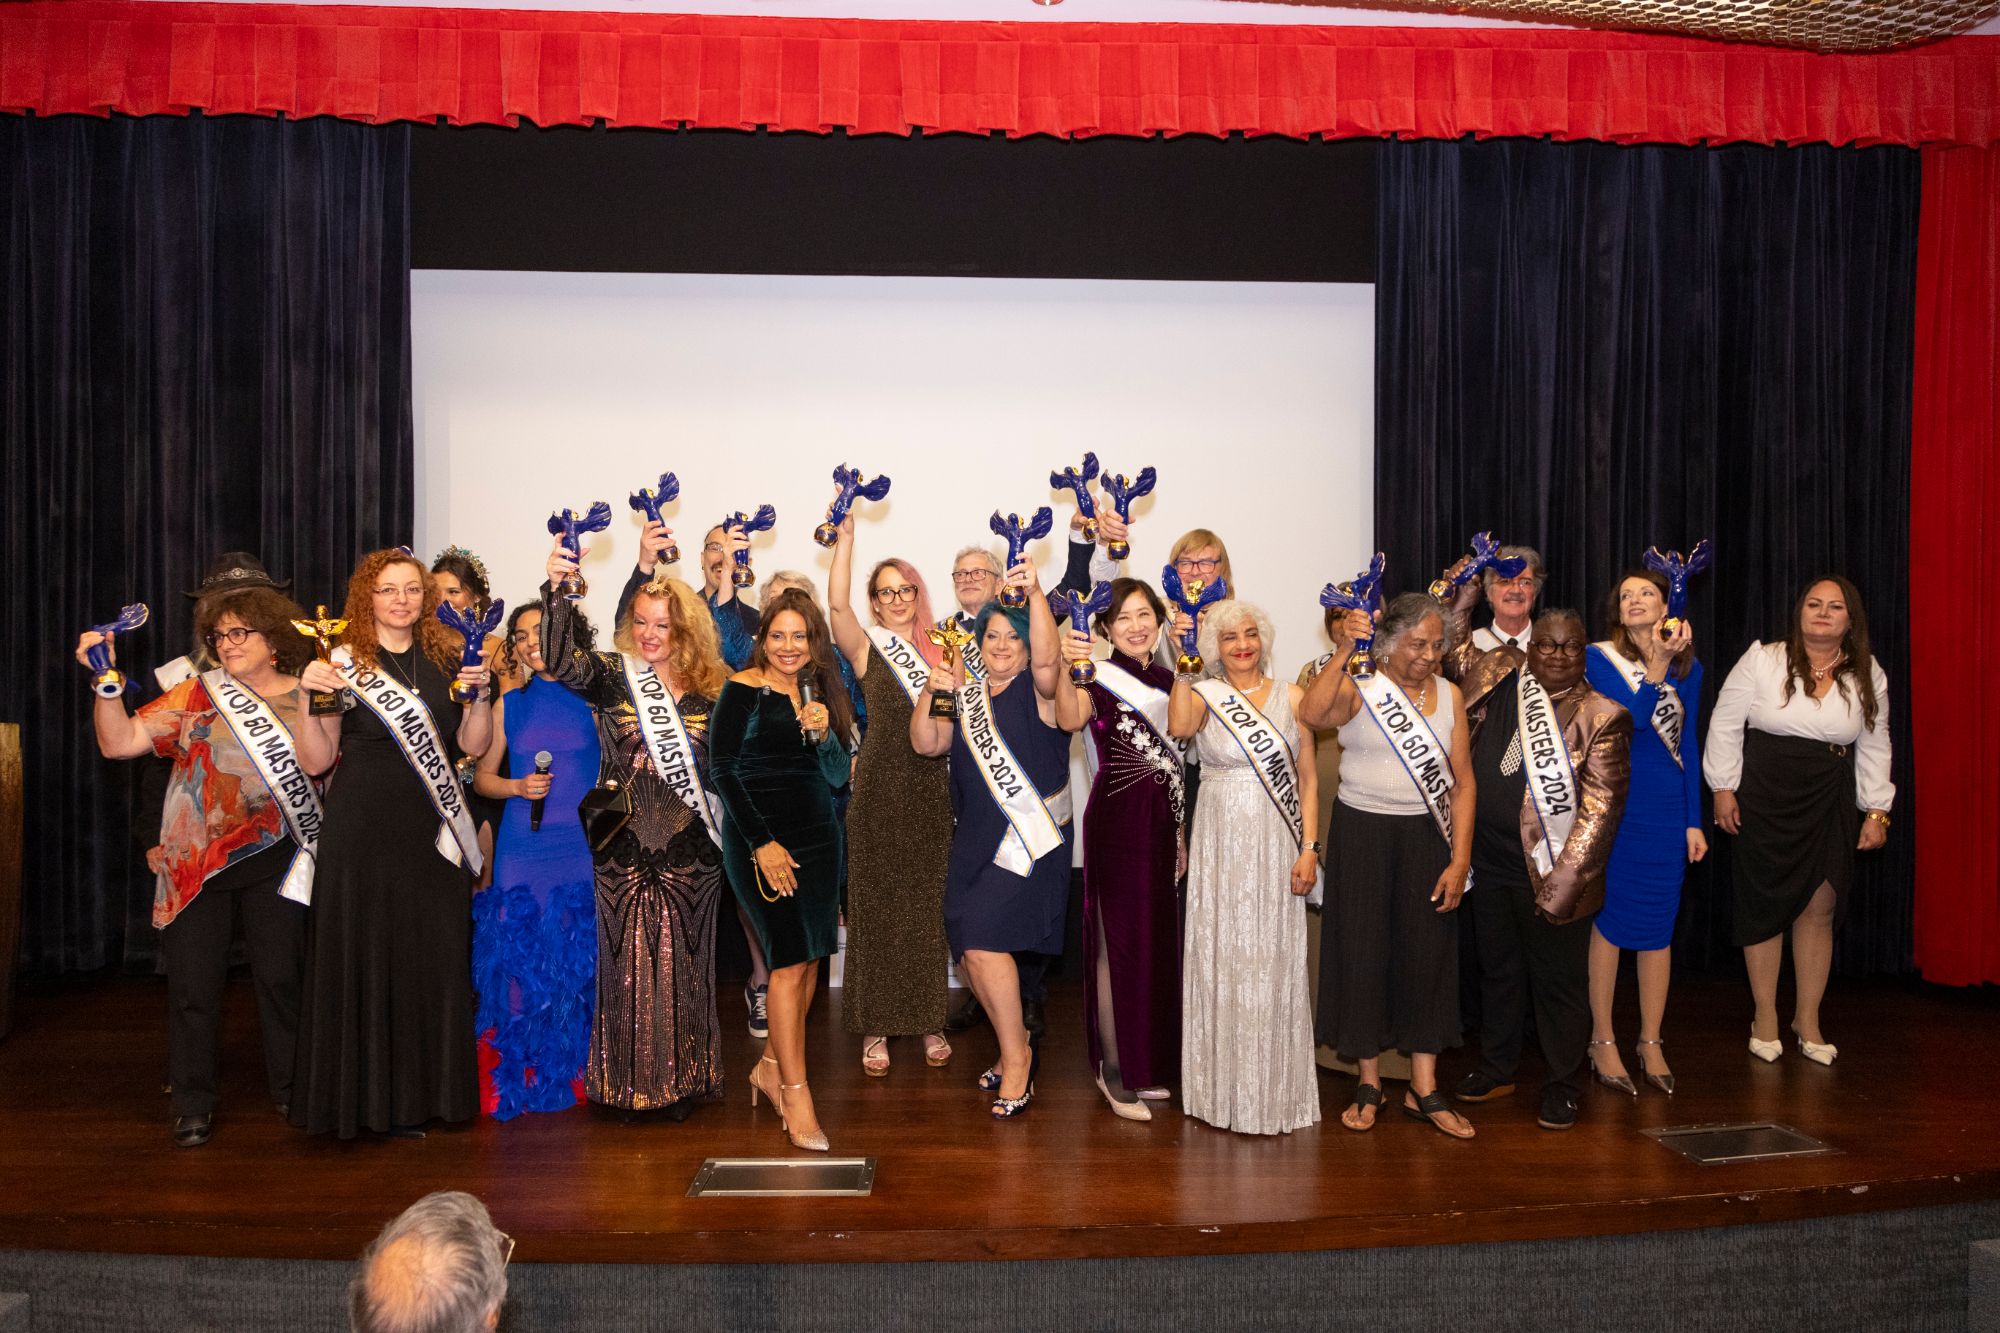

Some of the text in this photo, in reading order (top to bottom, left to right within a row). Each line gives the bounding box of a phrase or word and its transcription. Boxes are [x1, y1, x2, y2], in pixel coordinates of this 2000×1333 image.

[888, 644, 929, 688] TOP 60
[243, 716, 274, 738] 60
[257, 734, 312, 809] MASTERS
[376, 689, 407, 712] 60
[394, 707, 446, 781] MASTERS
[436, 778, 462, 819] 2024
[637, 671, 695, 800] TOP 60 MASTERS
[964, 685, 1023, 799] 60 MASTERS 2024
[1225, 703, 1299, 816] TOP 60 MASTERS
[1381, 701, 1414, 734] TOP
[1401, 734, 1429, 760] 60
[1521, 678, 1572, 817] 60 MASTERS 2024
